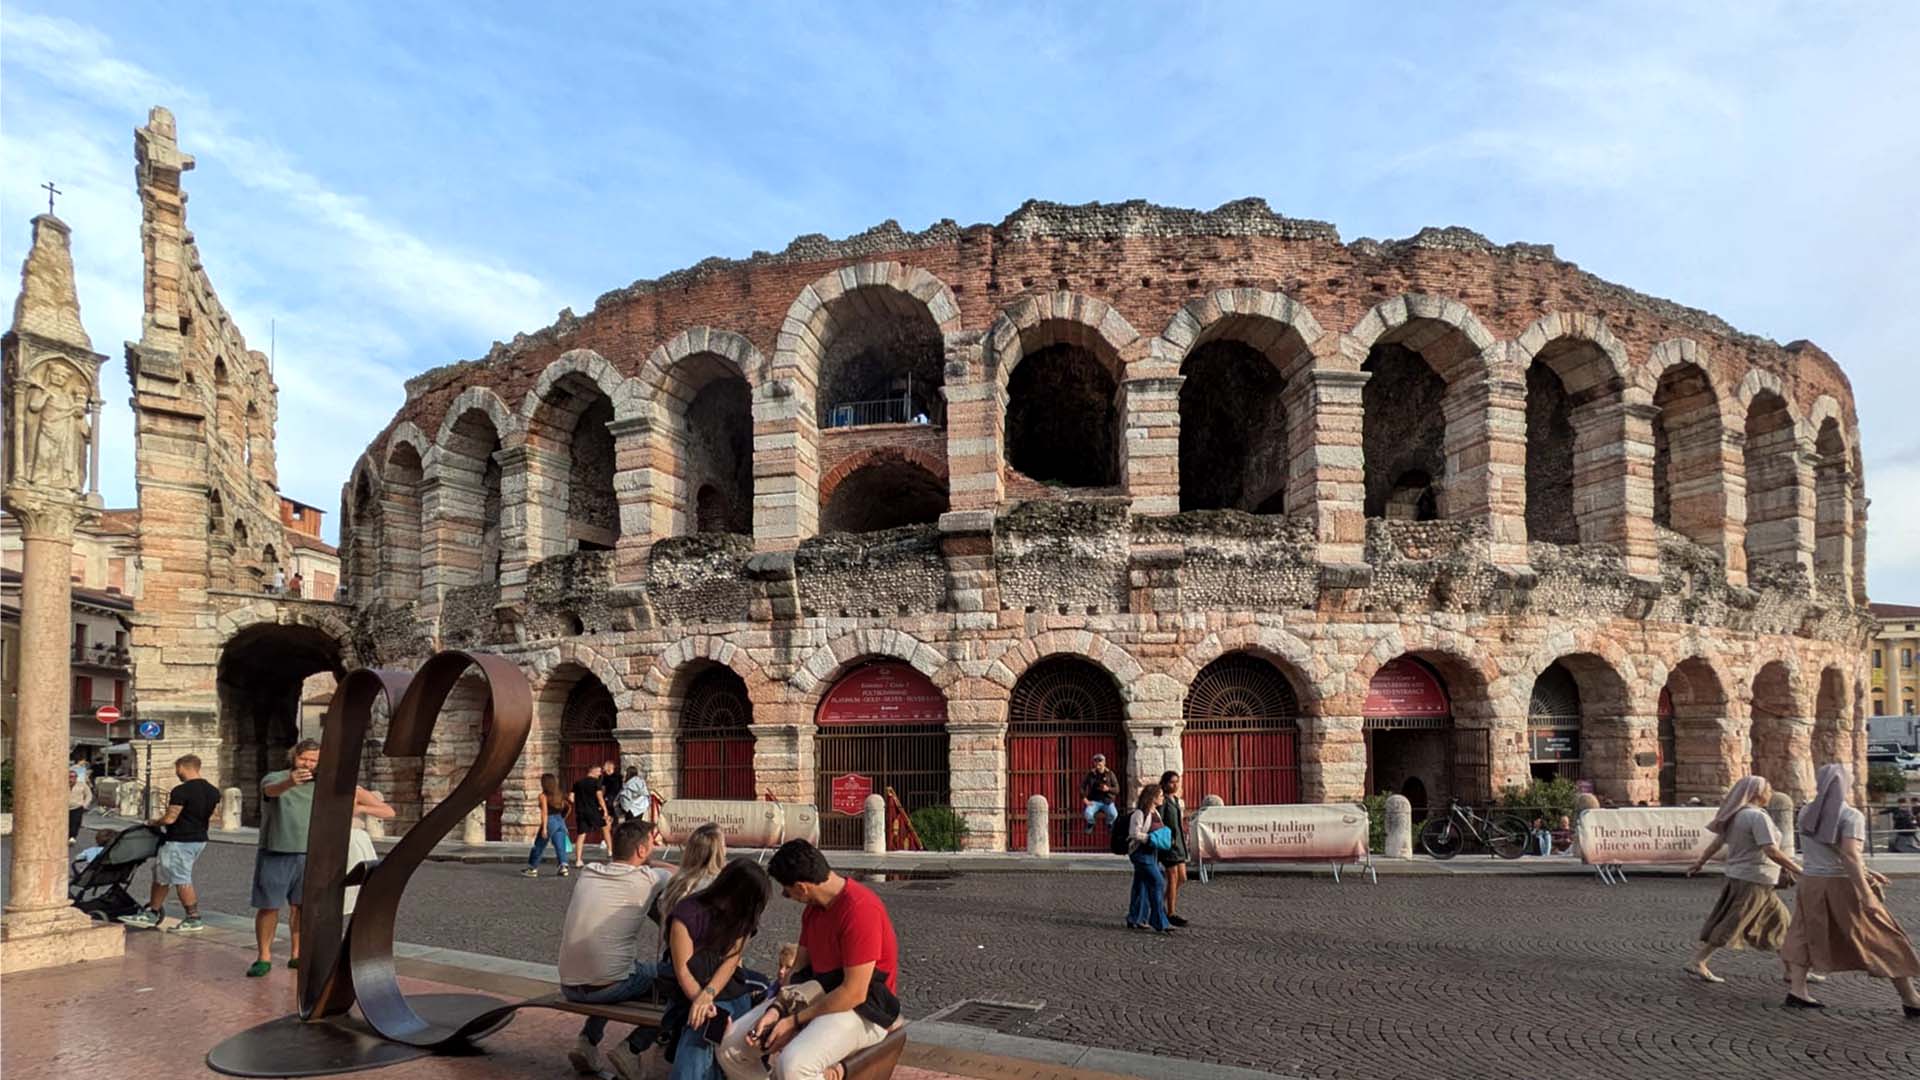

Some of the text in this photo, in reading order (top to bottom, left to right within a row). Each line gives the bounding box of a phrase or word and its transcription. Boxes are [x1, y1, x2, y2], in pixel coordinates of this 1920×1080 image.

[669, 813, 745, 825] The most Italian
[1211, 820, 1315, 833] The most Italian
[1591, 825, 1700, 838] The most Italian
[1213, 834, 1245, 847] place
[1250, 836, 1266, 845] on
[1595, 838, 1629, 854] place
[1633, 842, 1650, 850] on
